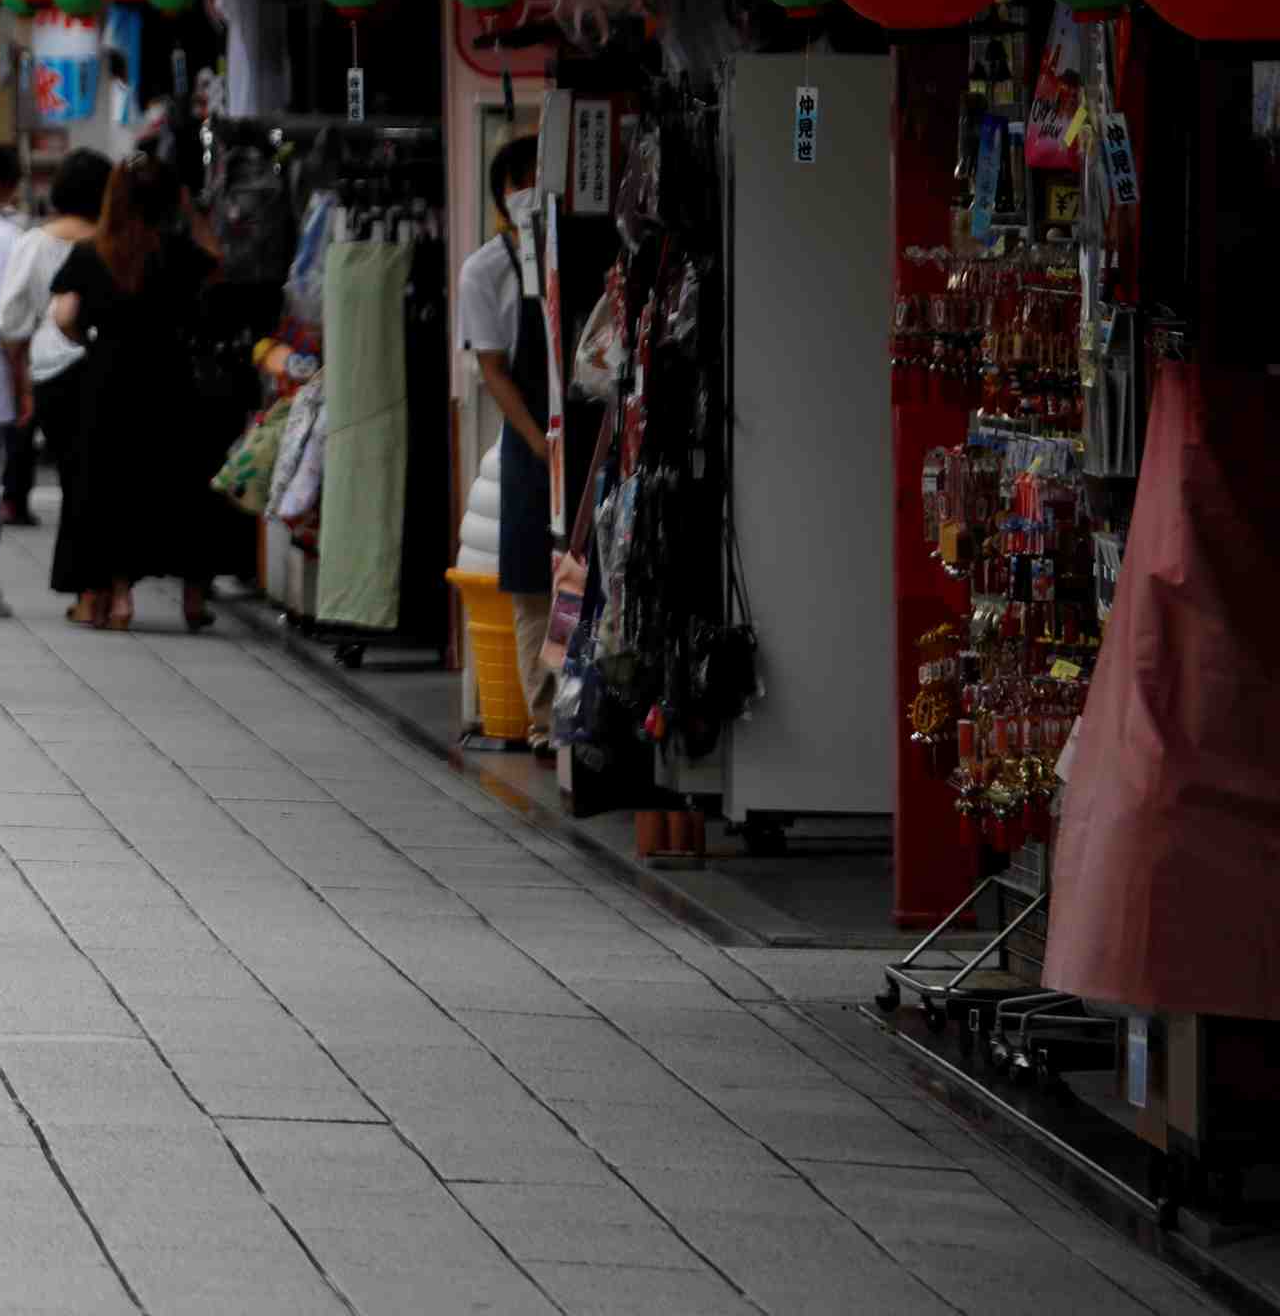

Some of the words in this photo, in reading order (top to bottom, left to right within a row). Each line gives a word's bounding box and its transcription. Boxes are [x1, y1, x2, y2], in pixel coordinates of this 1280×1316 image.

[798, 95, 814, 162] 仲見世
[1107, 121, 1136, 203] 仲見世
